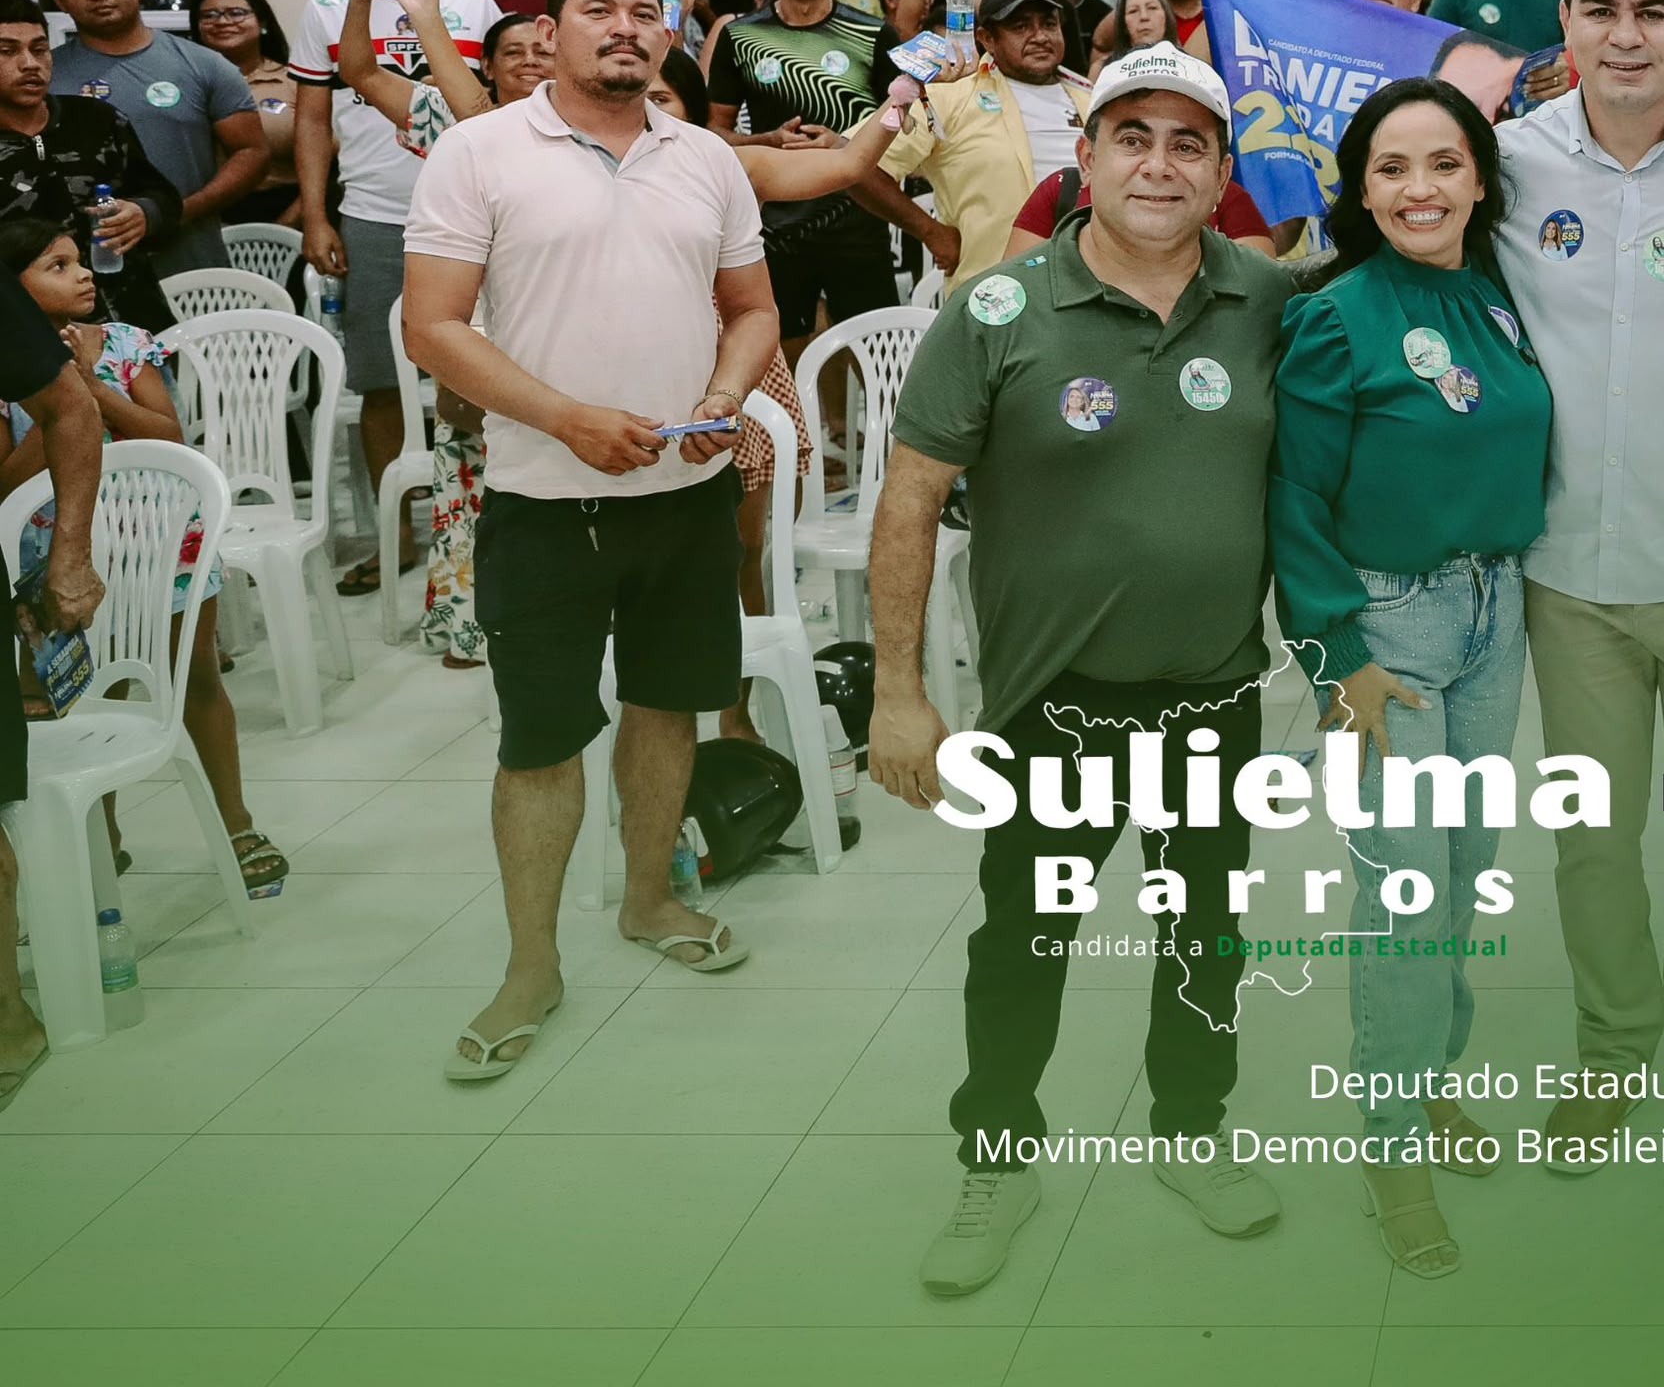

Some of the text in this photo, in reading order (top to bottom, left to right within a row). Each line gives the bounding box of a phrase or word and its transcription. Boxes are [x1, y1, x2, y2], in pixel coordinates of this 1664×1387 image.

[388, 43, 423, 52] SPFC
[1268, 38, 1308, 54] CANDIDATO
[1314, 50, 1353, 64] DEPUTADO
[1353, 58, 1385, 71] FEDERAL
[1120, 56, 1177, 73] Sulielma
[1562, 232, 1580, 241] 555
[1461, 386, 1479, 397] 555
[1091, 401, 1113, 410] 555
